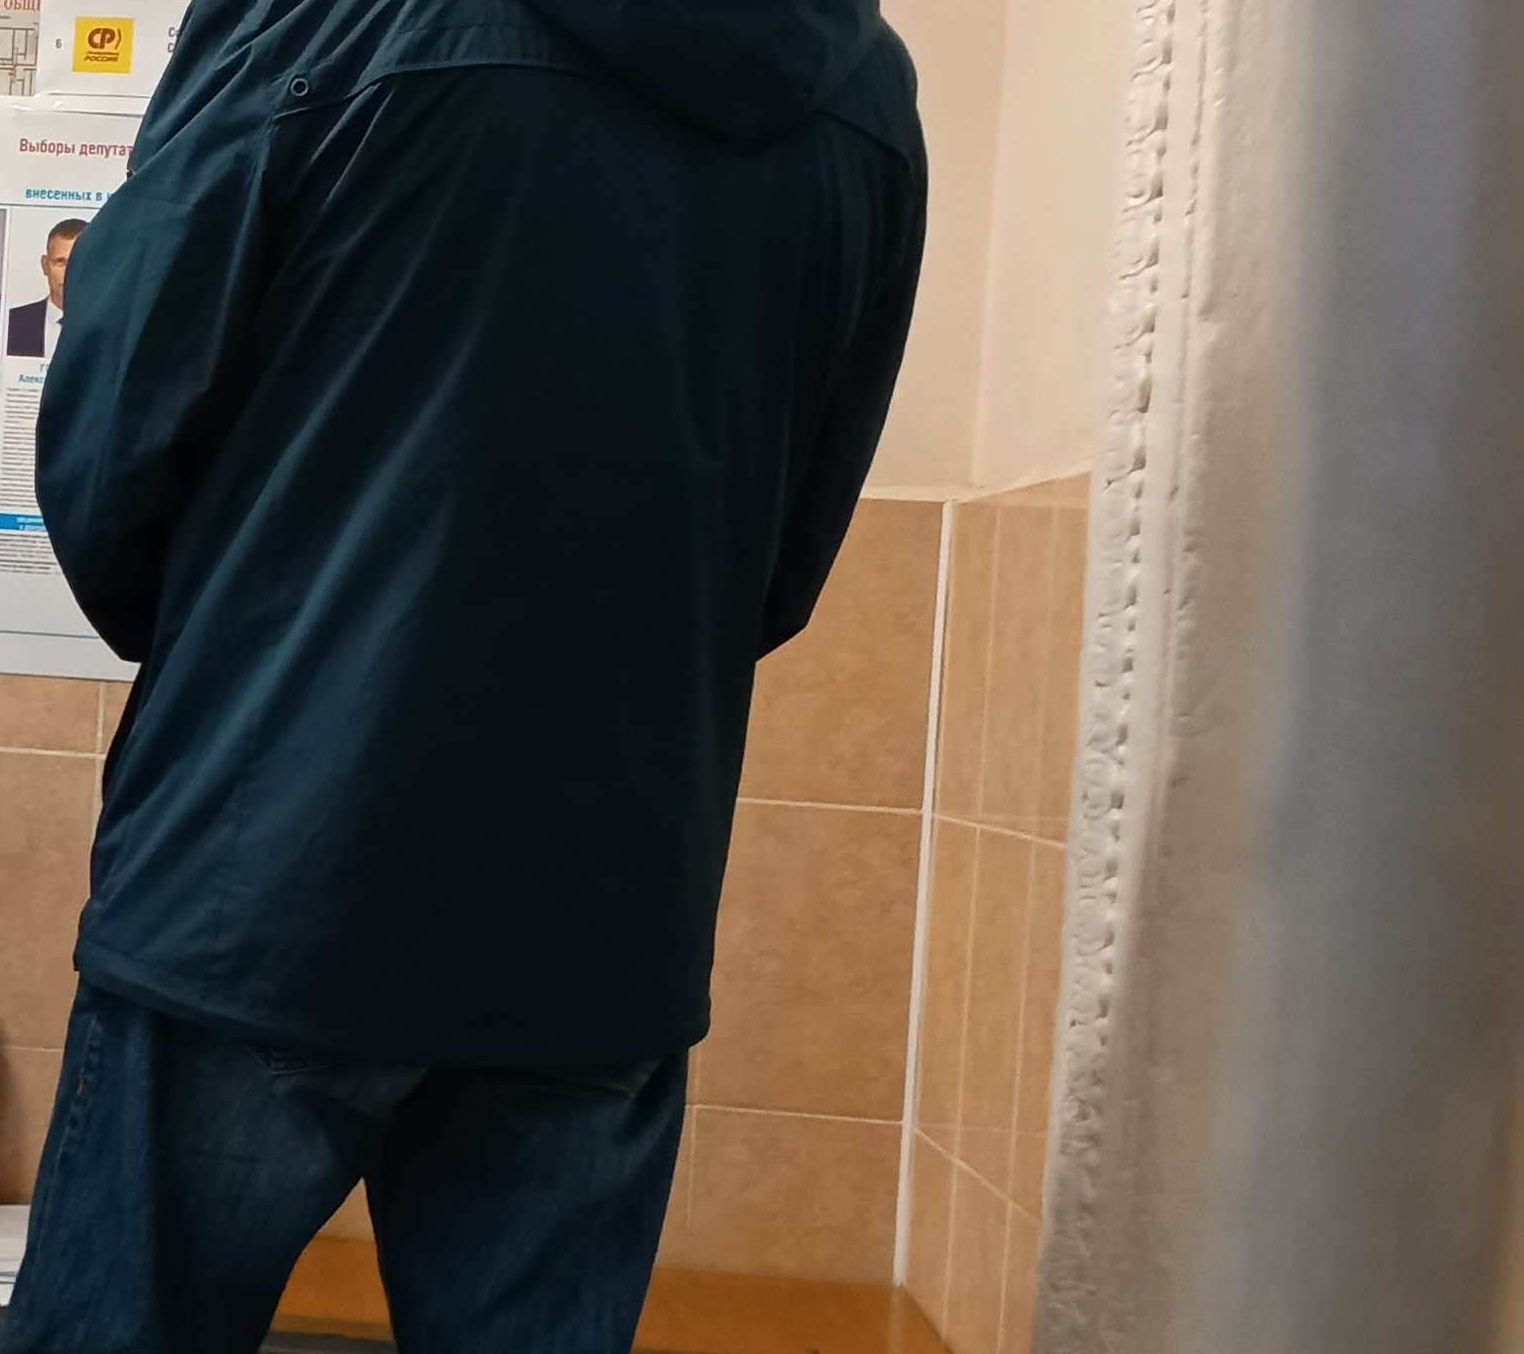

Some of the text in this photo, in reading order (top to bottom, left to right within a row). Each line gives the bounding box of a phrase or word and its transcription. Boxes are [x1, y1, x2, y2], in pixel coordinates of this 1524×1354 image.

[55, 39, 62, 49] 6
[19, 138, 76, 157] Выборы
[25, 189, 103, 202] внесенных в
